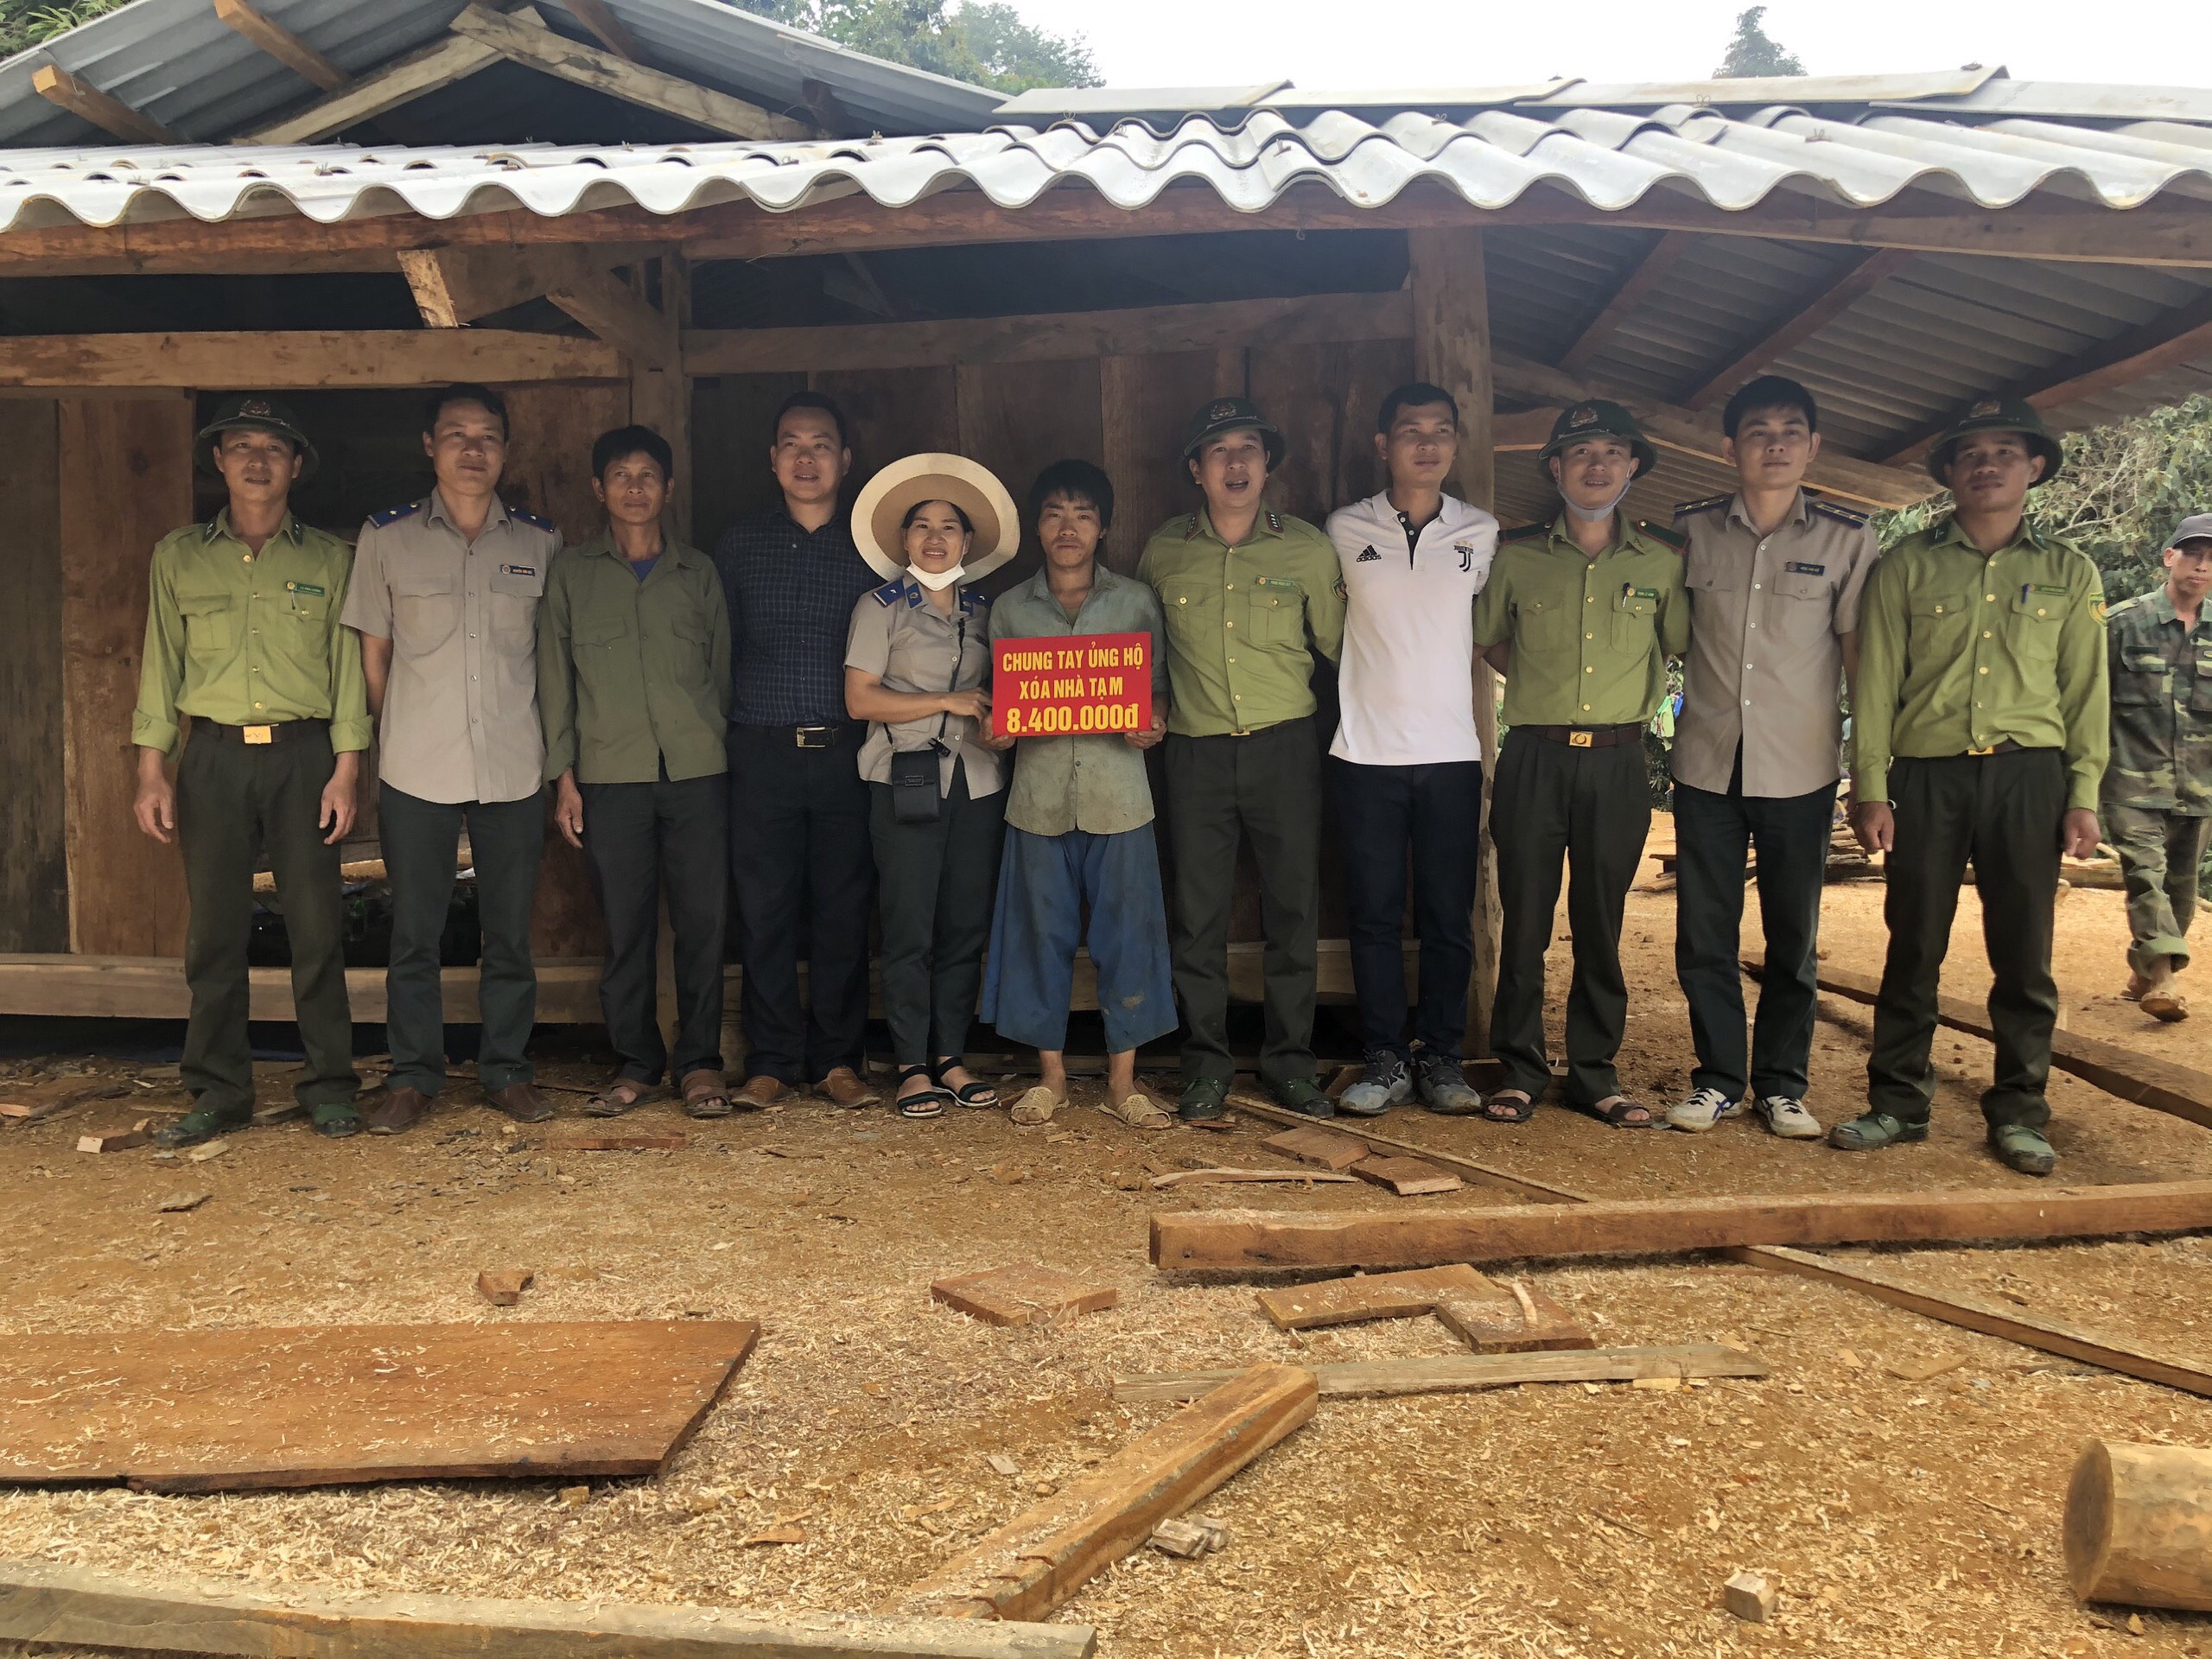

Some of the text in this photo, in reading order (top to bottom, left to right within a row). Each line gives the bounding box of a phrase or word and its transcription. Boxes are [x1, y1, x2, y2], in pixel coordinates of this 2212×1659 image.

[1356, 554, 1382, 563] adidas
[1003, 642, 1142, 671] CHUNG TAY ỦNG HỘ
[1020, 675, 1122, 700] XÓA NHÀ TẠM
[1007, 703, 1139, 733] 8.400.000đ
